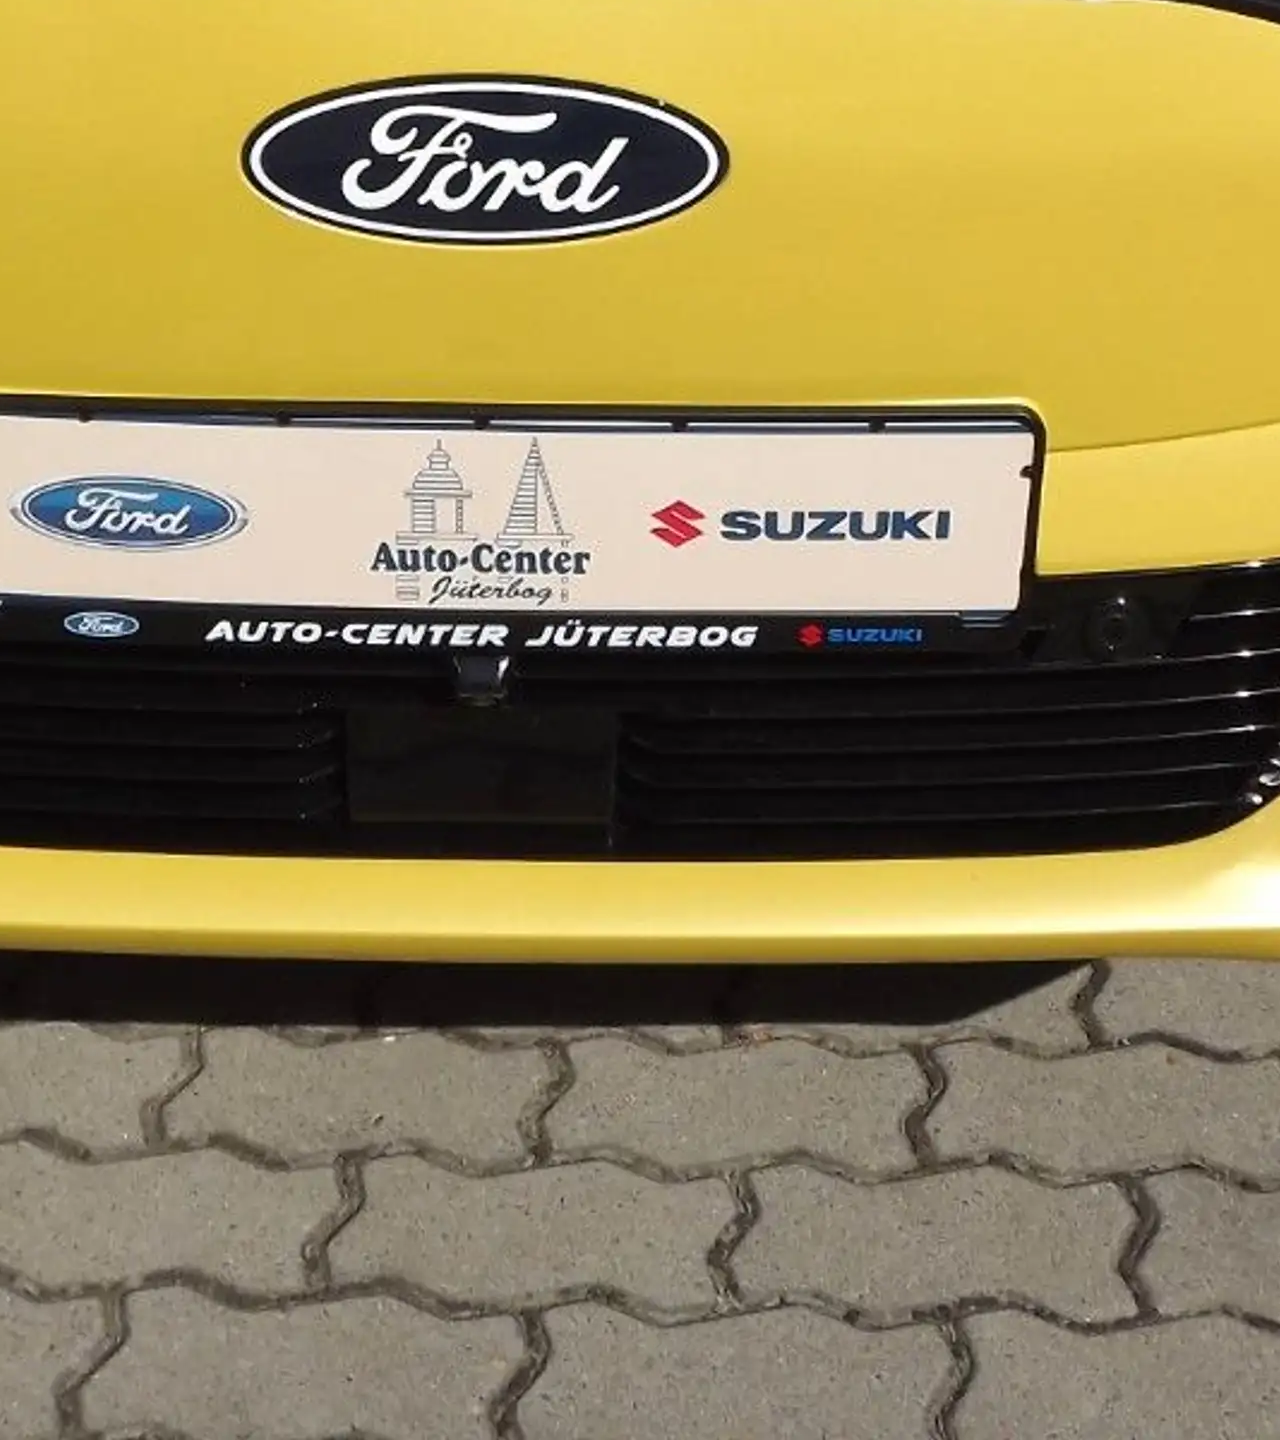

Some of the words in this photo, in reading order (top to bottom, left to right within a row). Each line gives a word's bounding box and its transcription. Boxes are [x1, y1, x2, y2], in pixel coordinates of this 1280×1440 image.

[341, 104, 629, 213] Ford
[64, 487, 191, 535] Ford
[720, 510, 951, 541] SUZUKI
[371, 542, 592, 575] Auto-Center
[428, 575, 554, 606] Jüterbog
[76, 613, 125, 635] Ford
[204, 620, 510, 647] AUTO-CENTER
[524, 618, 759, 648] JÜTERBOG
[828, 627, 922, 643] SUZUKI
